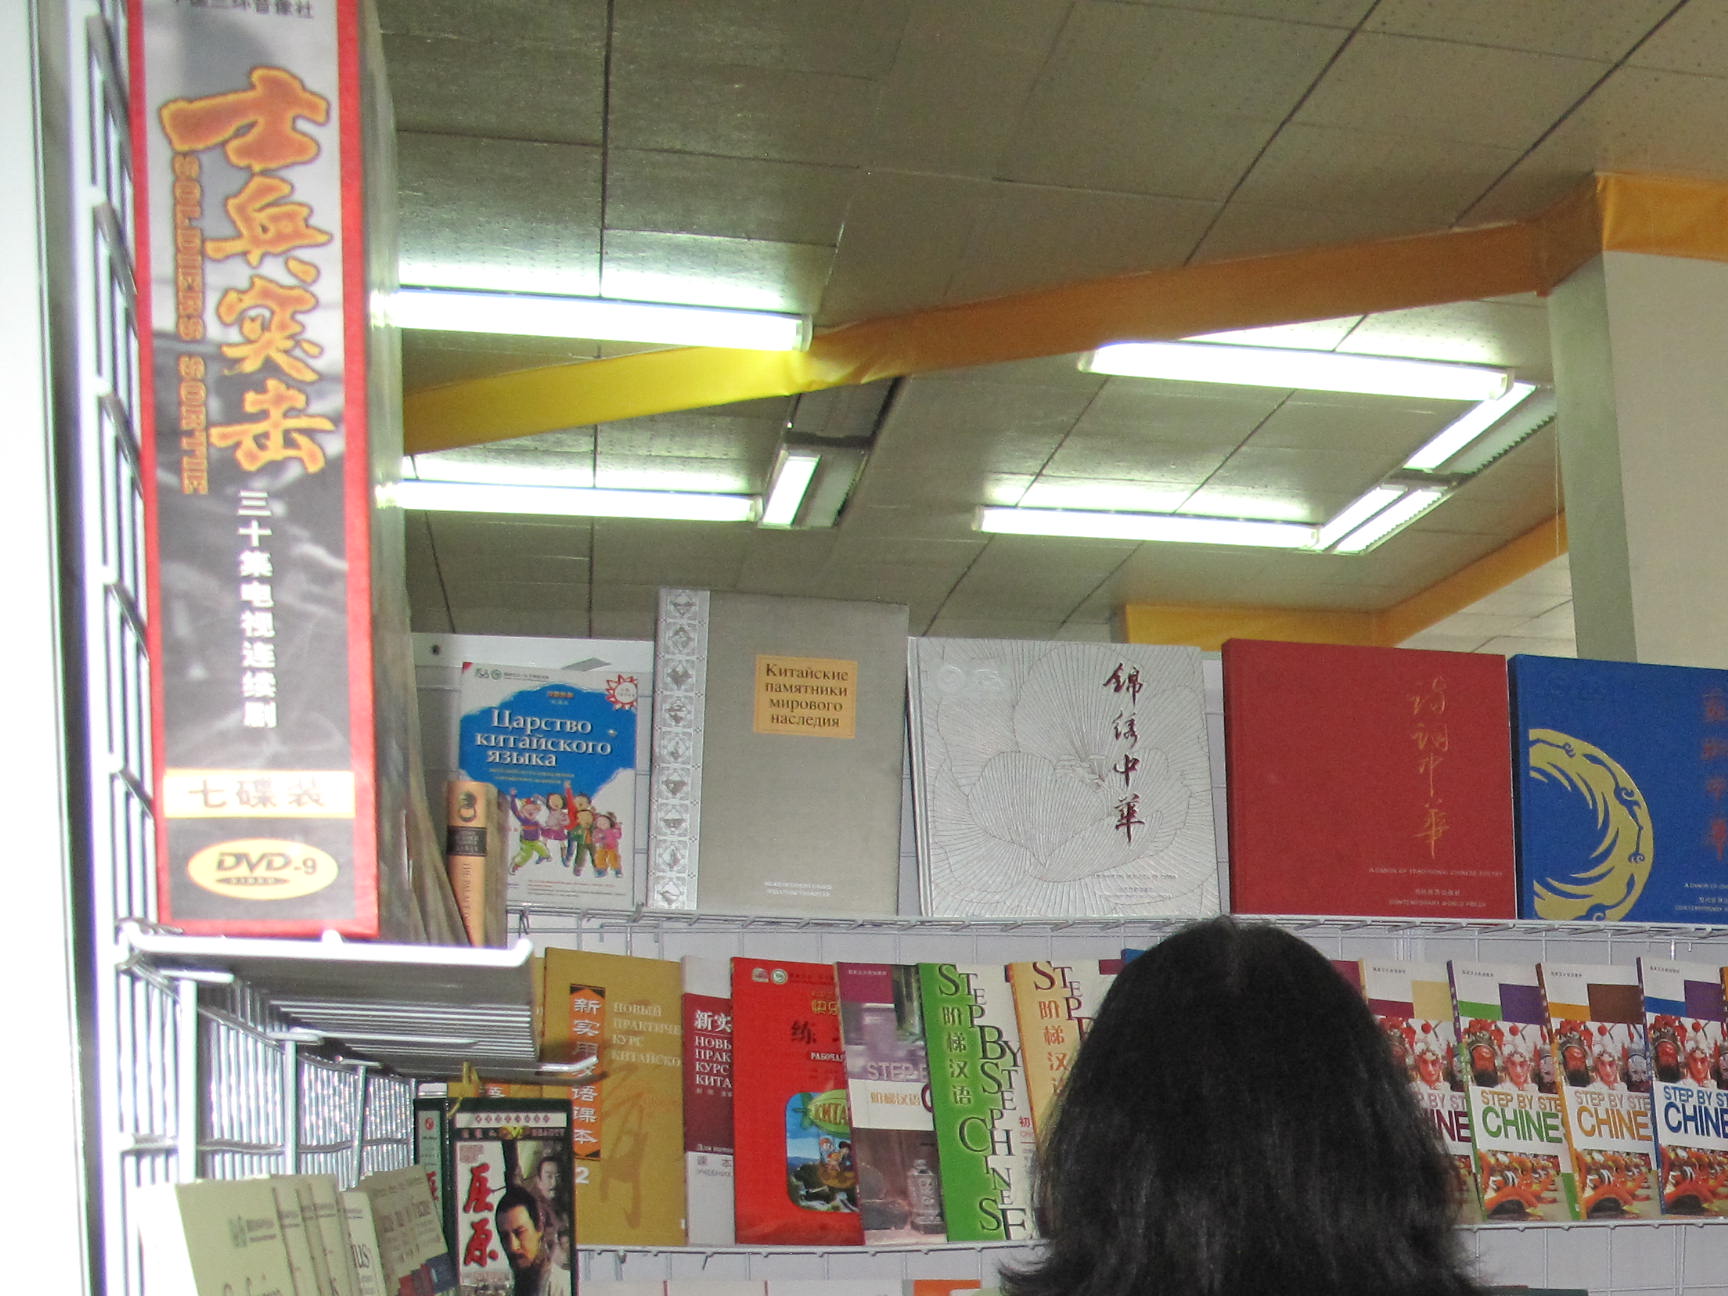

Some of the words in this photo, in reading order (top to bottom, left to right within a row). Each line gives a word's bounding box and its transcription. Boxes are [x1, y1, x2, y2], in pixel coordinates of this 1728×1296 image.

[237, 490, 278, 729] 三十集电视连续剧
[765, 663, 849, 681] Китайские
[765, 682, 848, 697] памятники
[769, 698, 843, 713] мирового
[491, 708, 593, 736] Царство
[771, 713, 840, 729] наследия
[475, 732, 613, 756] китайского
[486, 751, 558, 768] языка
[695, 1062, 731, 1075] КУРС
[695, 1075, 733, 1089] КИТА
[1480, 1089, 1514, 1109] STEP
[1516, 1095, 1534, 1110] BY
[1574, 1090, 1607, 1108] STEP
[1609, 1092, 1626, 1109] BY
[1663, 1085, 1694, 1103] STEP
[1697, 1088, 1713, 1106] BY
[576, 1166, 590, 1184] 2
[463, 1162, 500, 1268] 屈原
